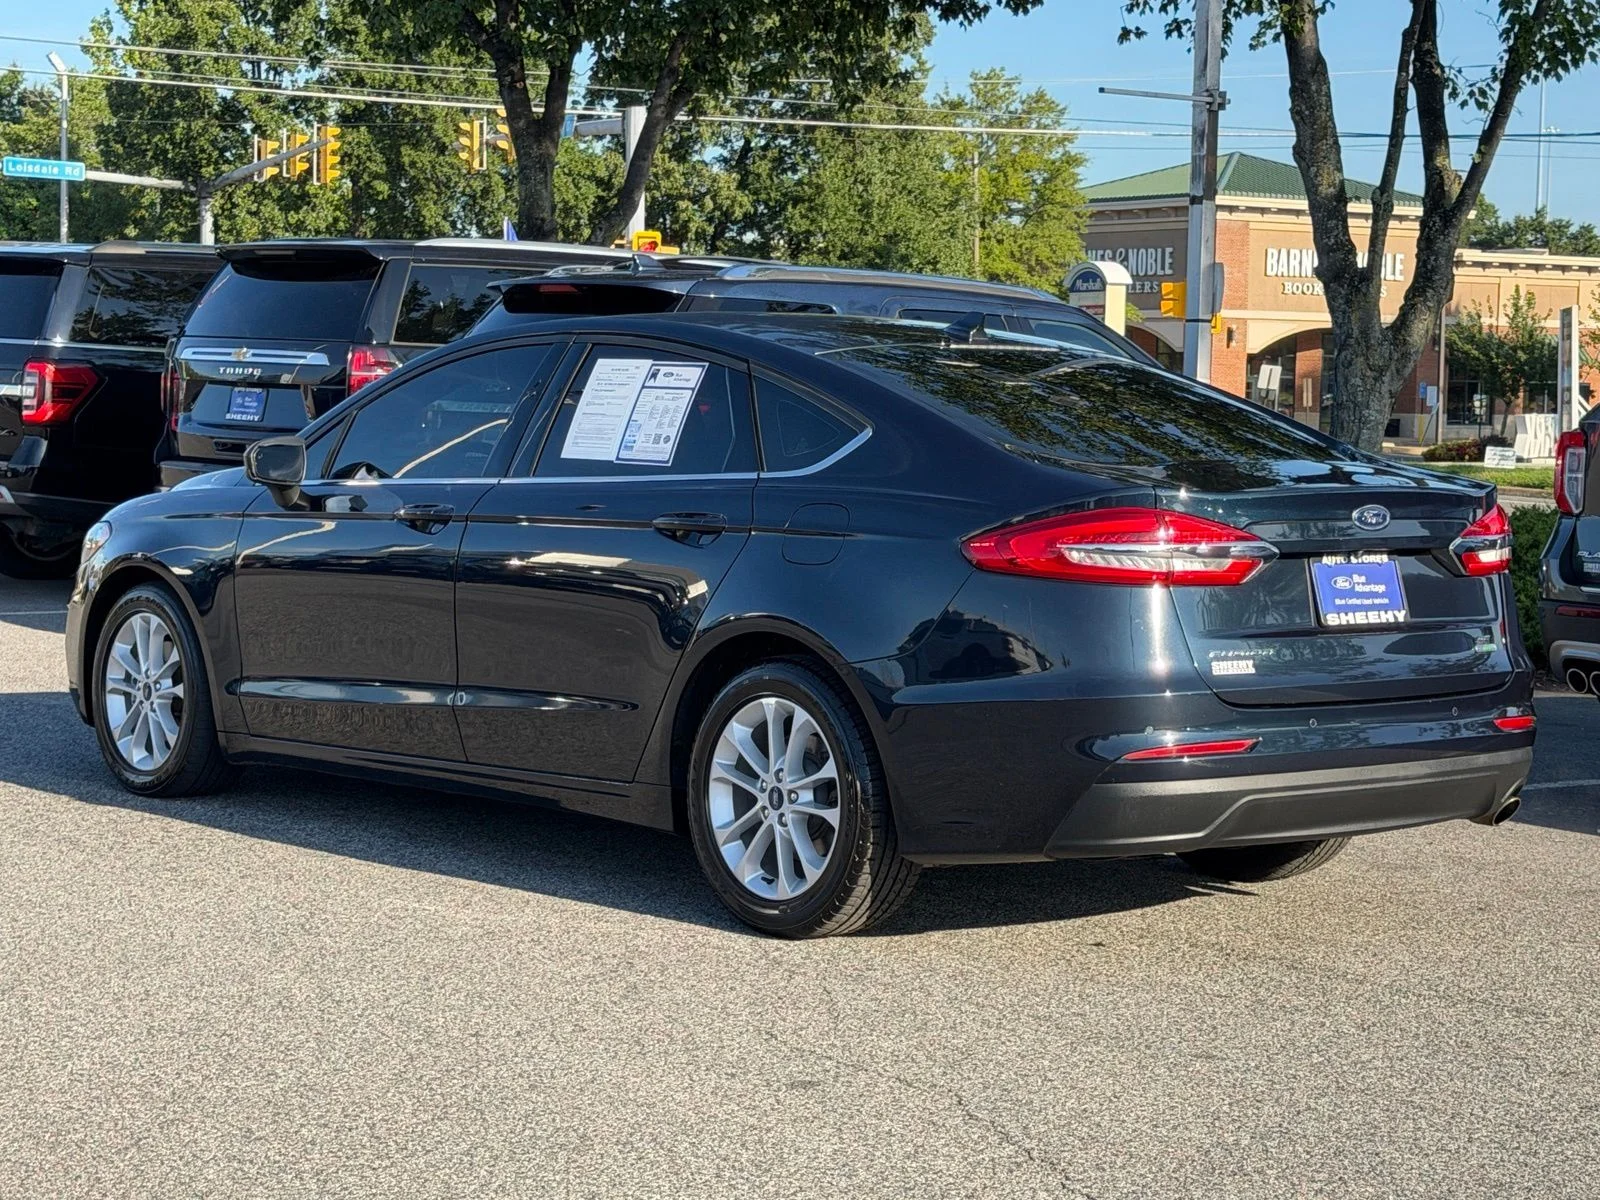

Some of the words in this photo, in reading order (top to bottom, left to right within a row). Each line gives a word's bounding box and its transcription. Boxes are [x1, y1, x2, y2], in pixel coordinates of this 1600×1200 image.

[8, 161, 59, 175] Loisdale
[64, 166, 80, 176] Rd
[1128, 247, 1174, 276] NOBLE
[1321, 555, 1349, 565] AUTO
[1350, 554, 1389, 564] STORES
[1352, 573, 1366, 583] Blue
[1354, 583, 1386, 594] Advantage
[1326, 610, 1406, 626] SHEEHY
